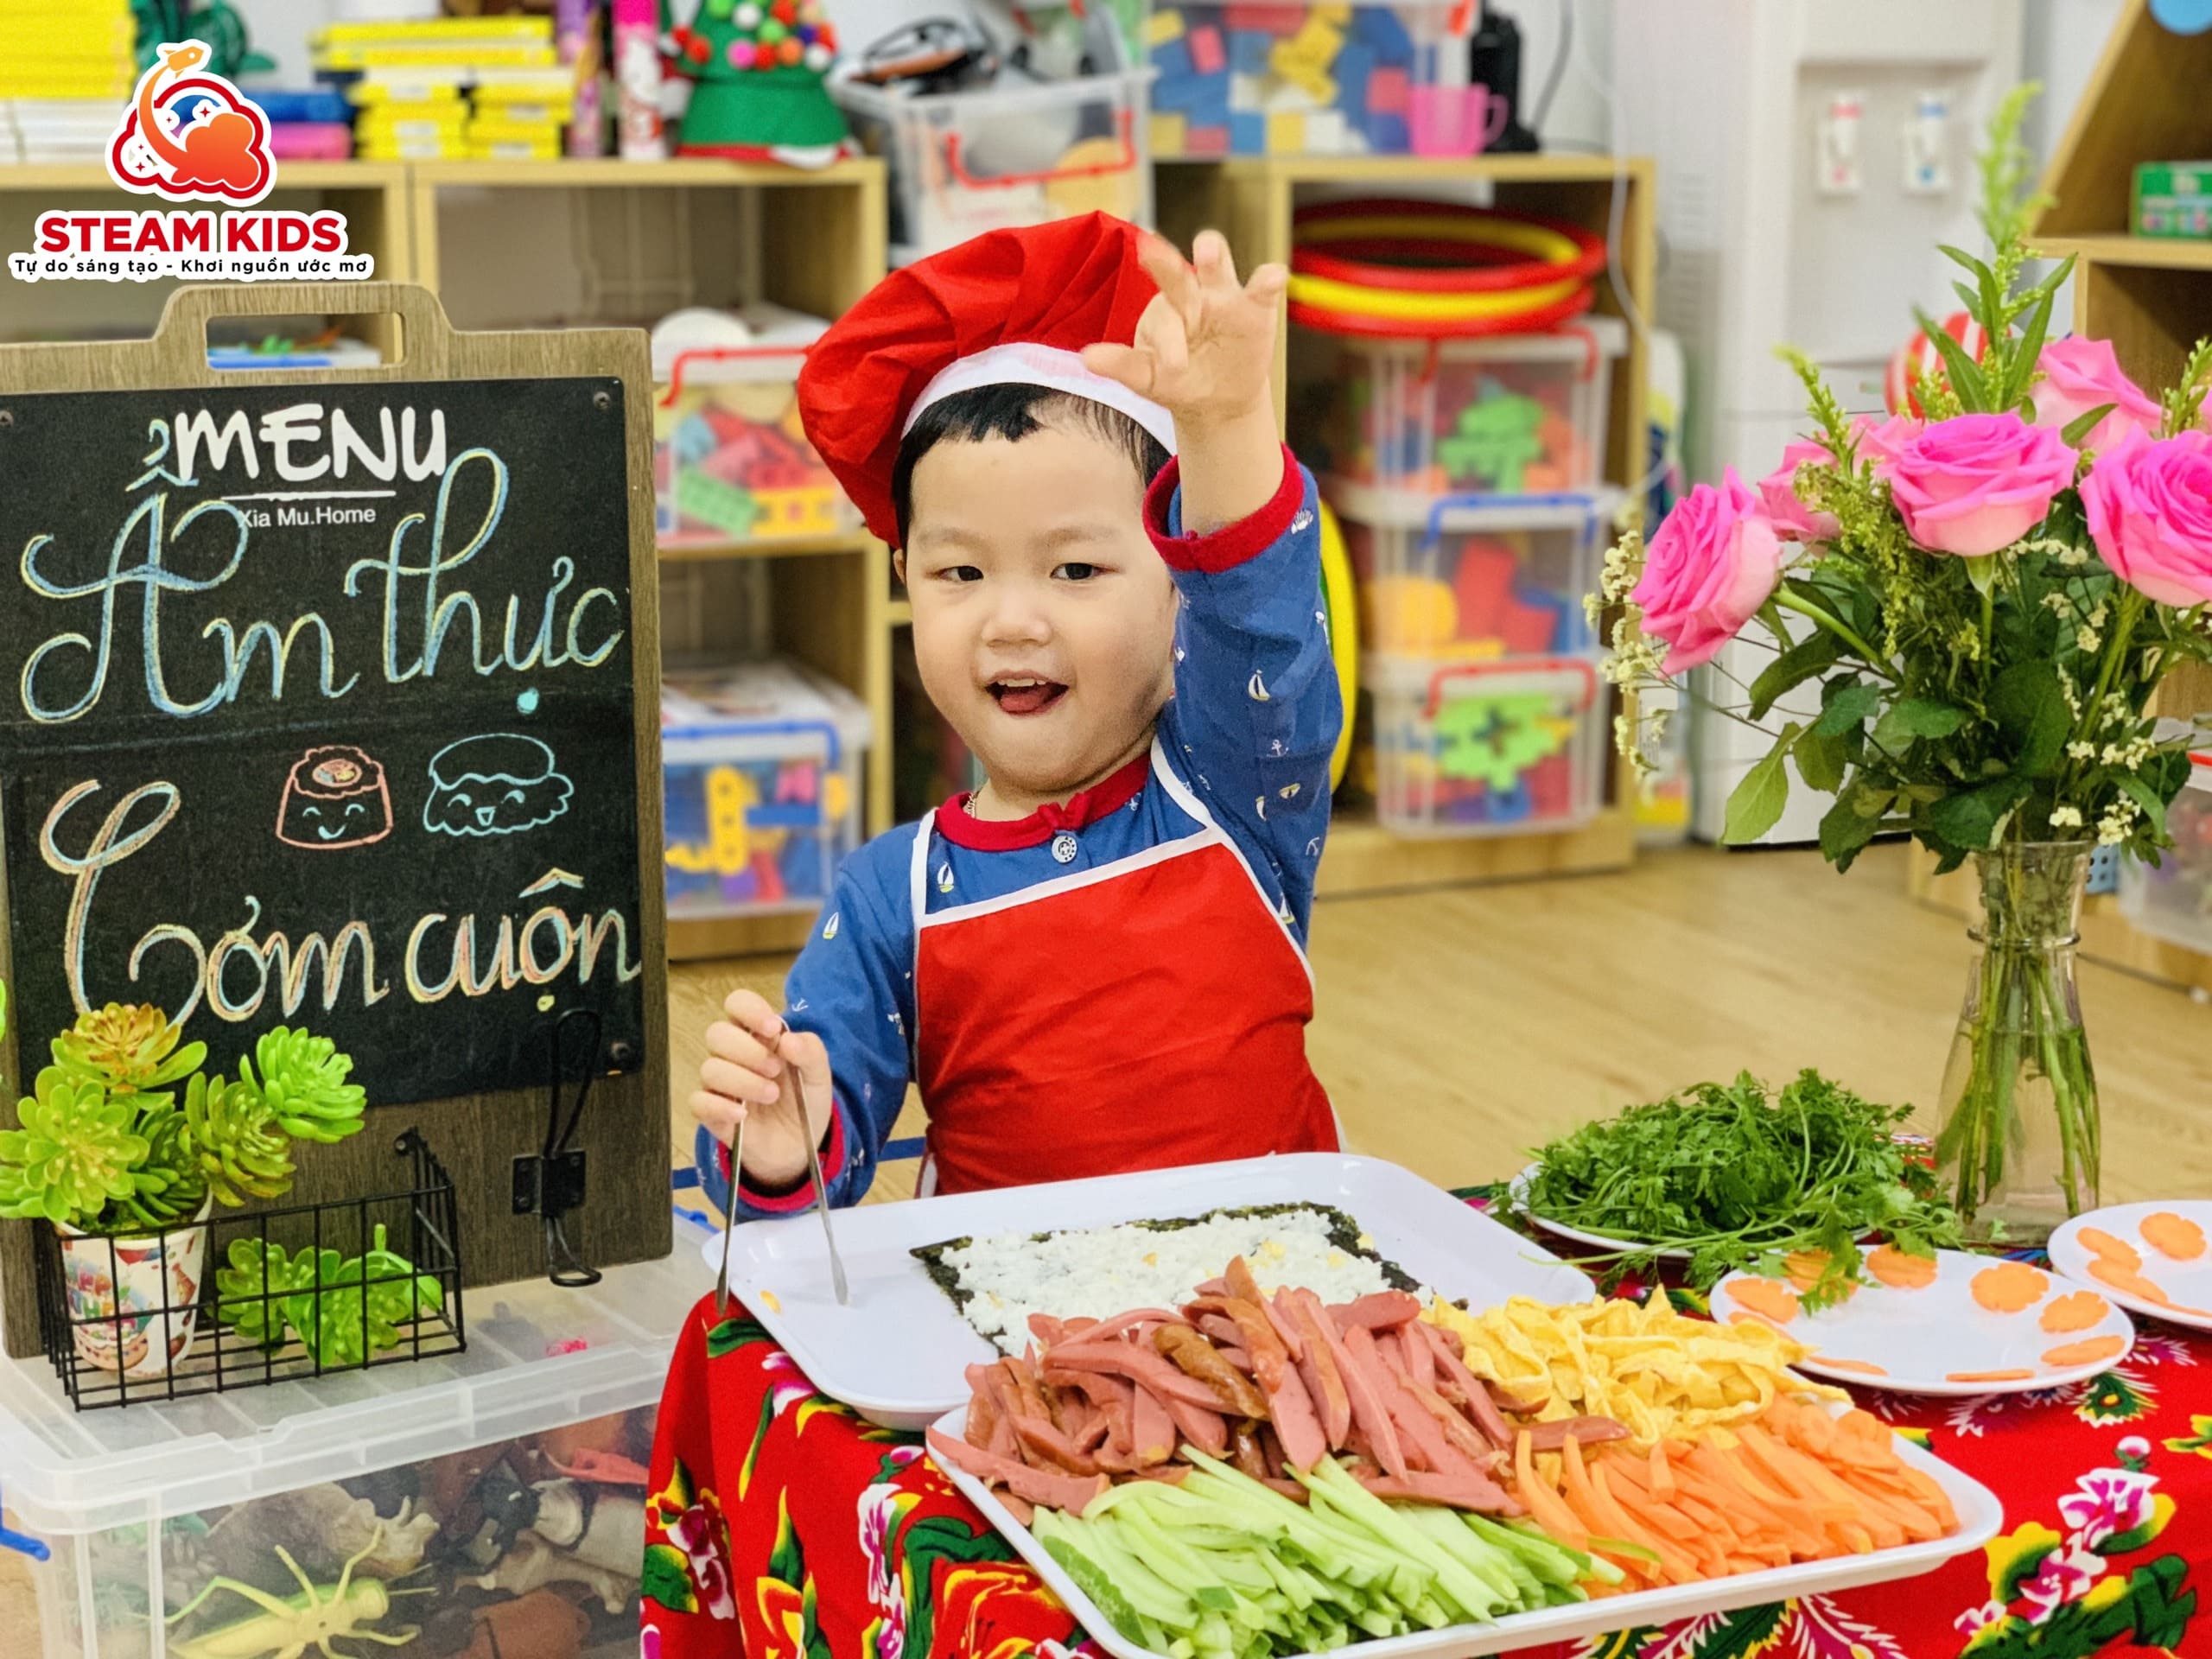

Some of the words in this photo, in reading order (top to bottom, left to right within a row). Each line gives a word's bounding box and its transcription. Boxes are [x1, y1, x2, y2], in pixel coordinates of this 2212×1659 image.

[175, 403, 447, 482] MENU
[238, 511, 271, 528] Xia
[276, 506, 377, 527] Mu.Home
[344, 448, 626, 713] thực
[40, 779, 390, 1027] Cơm
[405, 867, 641, 1013] cuộn
